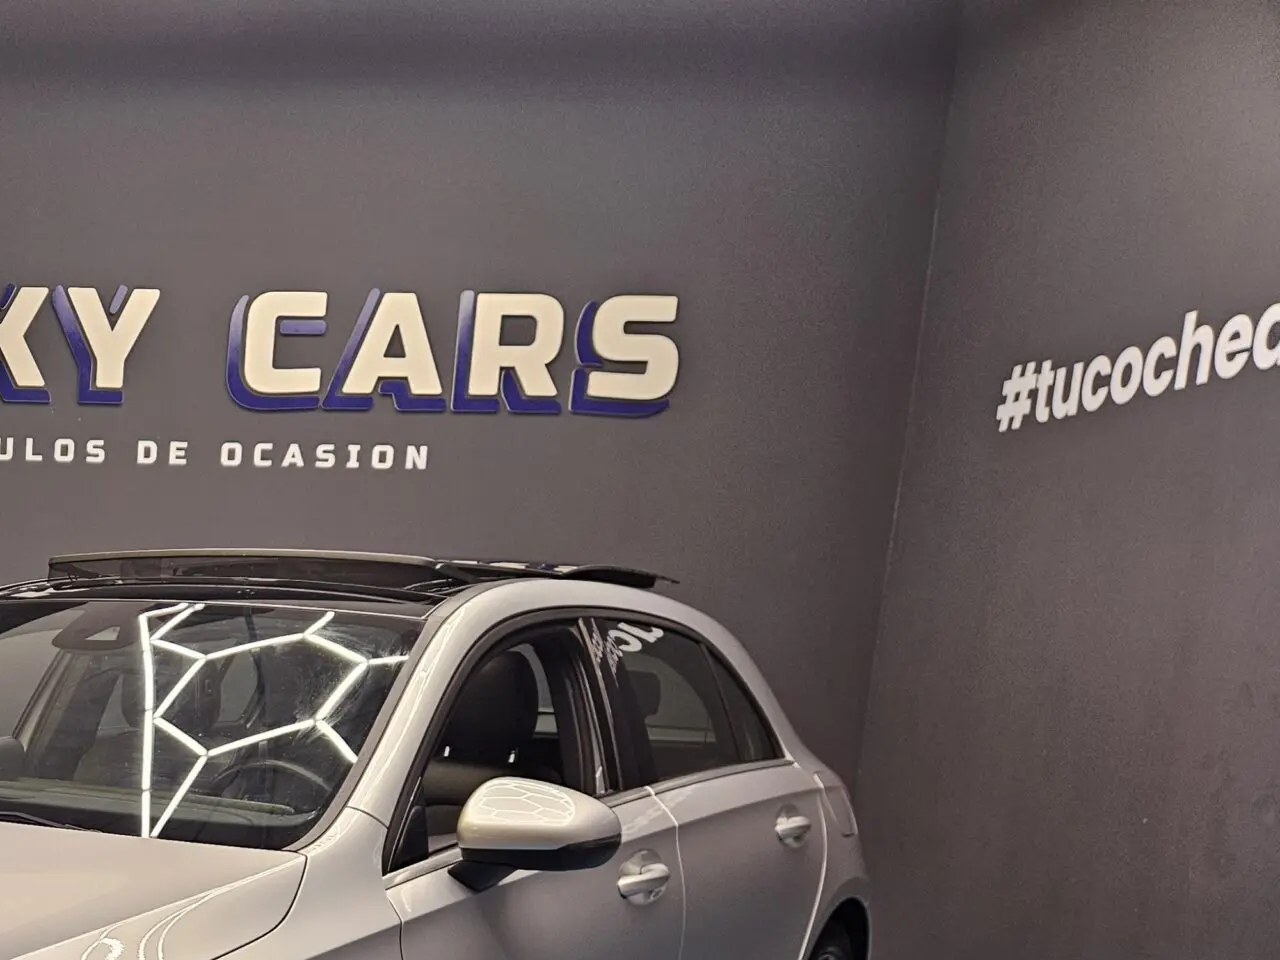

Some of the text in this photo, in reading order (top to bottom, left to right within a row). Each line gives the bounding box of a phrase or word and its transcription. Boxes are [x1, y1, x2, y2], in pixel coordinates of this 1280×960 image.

[227, 288, 679, 418] CARS
[136, 440, 188, 465] DE
[220, 442, 428, 470] OCASION
